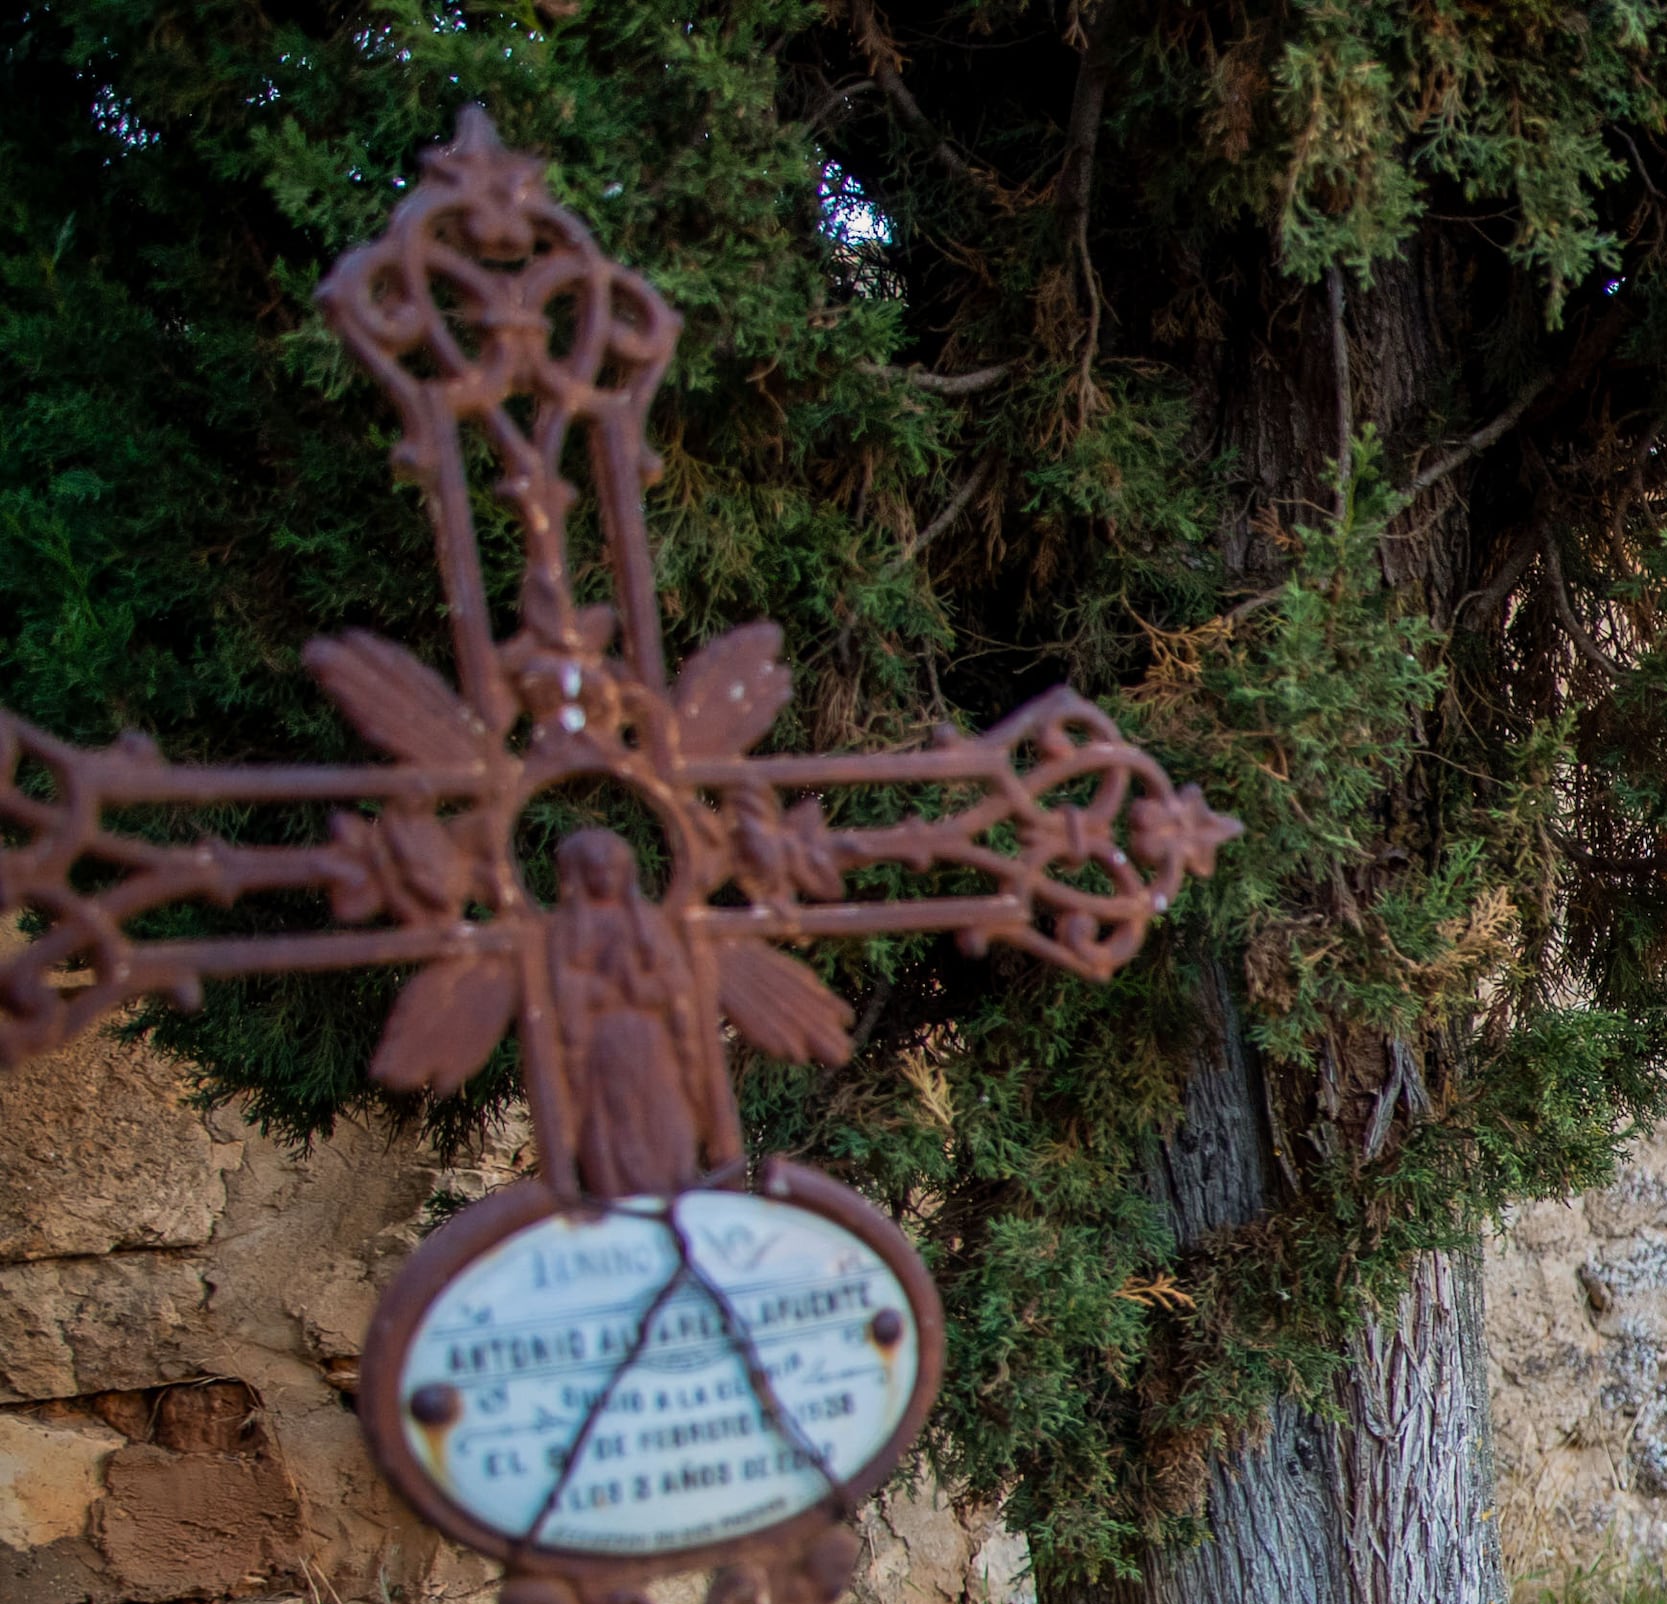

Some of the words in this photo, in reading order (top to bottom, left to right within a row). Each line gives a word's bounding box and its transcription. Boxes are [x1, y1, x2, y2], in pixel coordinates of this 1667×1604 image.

[449, 1328, 585, 1371] ANTONIO
[598, 1309, 733, 1354] ALARE
[482, 1450, 528, 1479] EL
[596, 1434, 625, 1461] DE
[637, 1412, 750, 1451] FEBRERO
[567, 1480, 623, 1512] LOS
[662, 1459, 732, 1495] AÑOS
